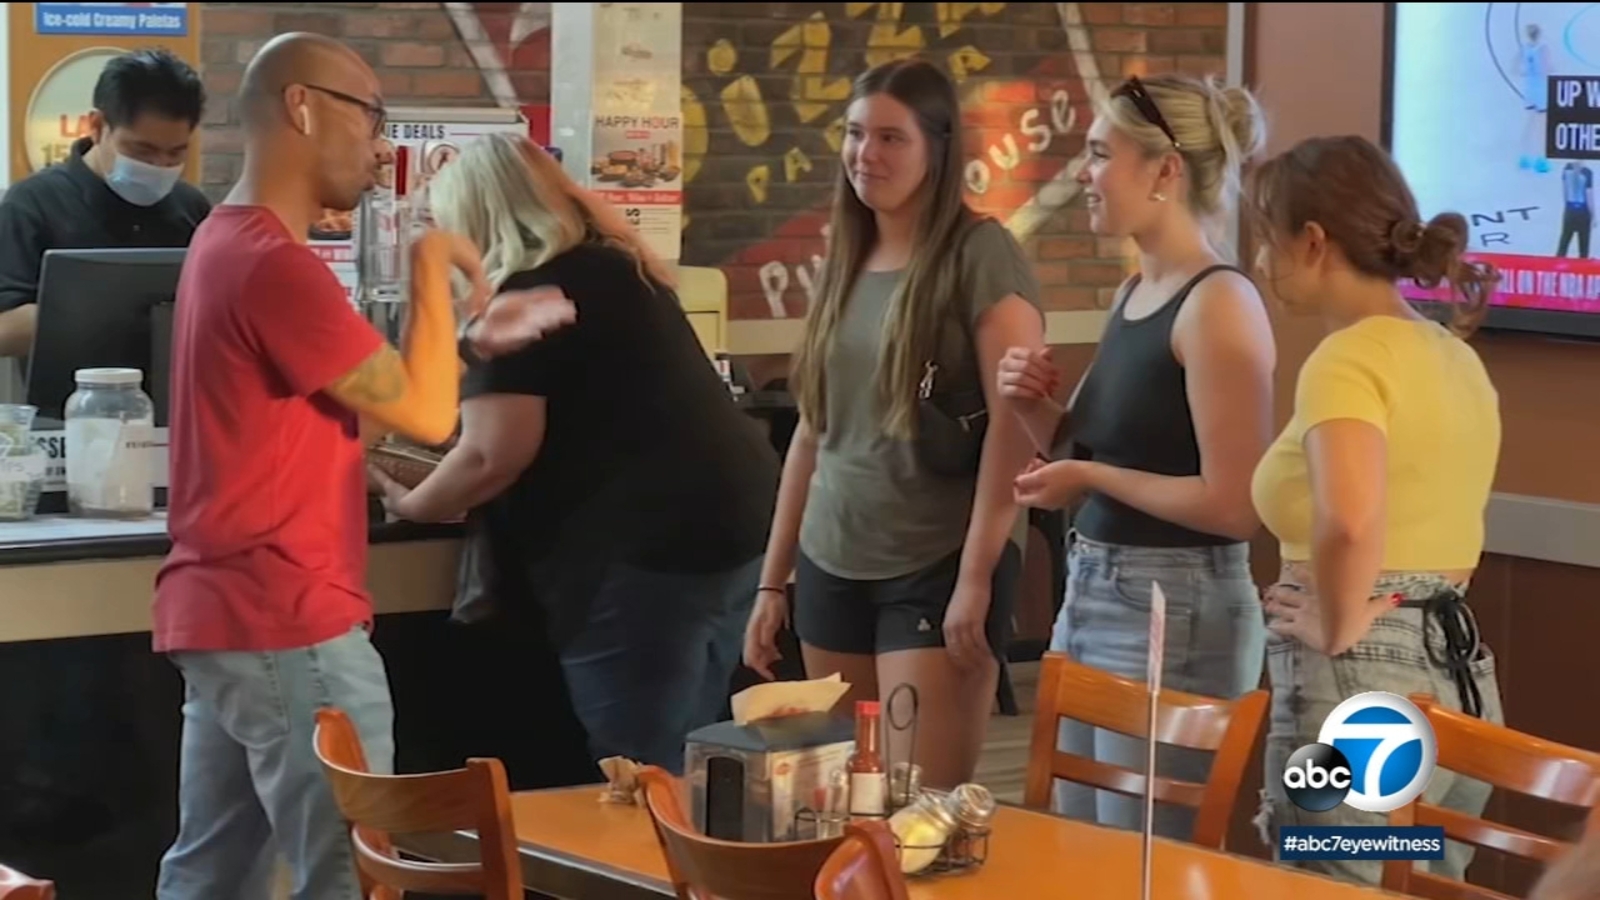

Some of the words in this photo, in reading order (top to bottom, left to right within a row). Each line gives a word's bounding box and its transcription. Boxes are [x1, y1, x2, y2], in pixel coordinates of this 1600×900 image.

[43, 12, 92, 27] Ice-cold
[93, 13, 136, 29] Creamy
[1556, 80, 1582, 108] UP
[595, 116, 638, 128] HAPPY
[642, 116, 679, 129] HOUR
[403, 124, 445, 139] DEALS
[1536, 271, 1557, 298] THE
